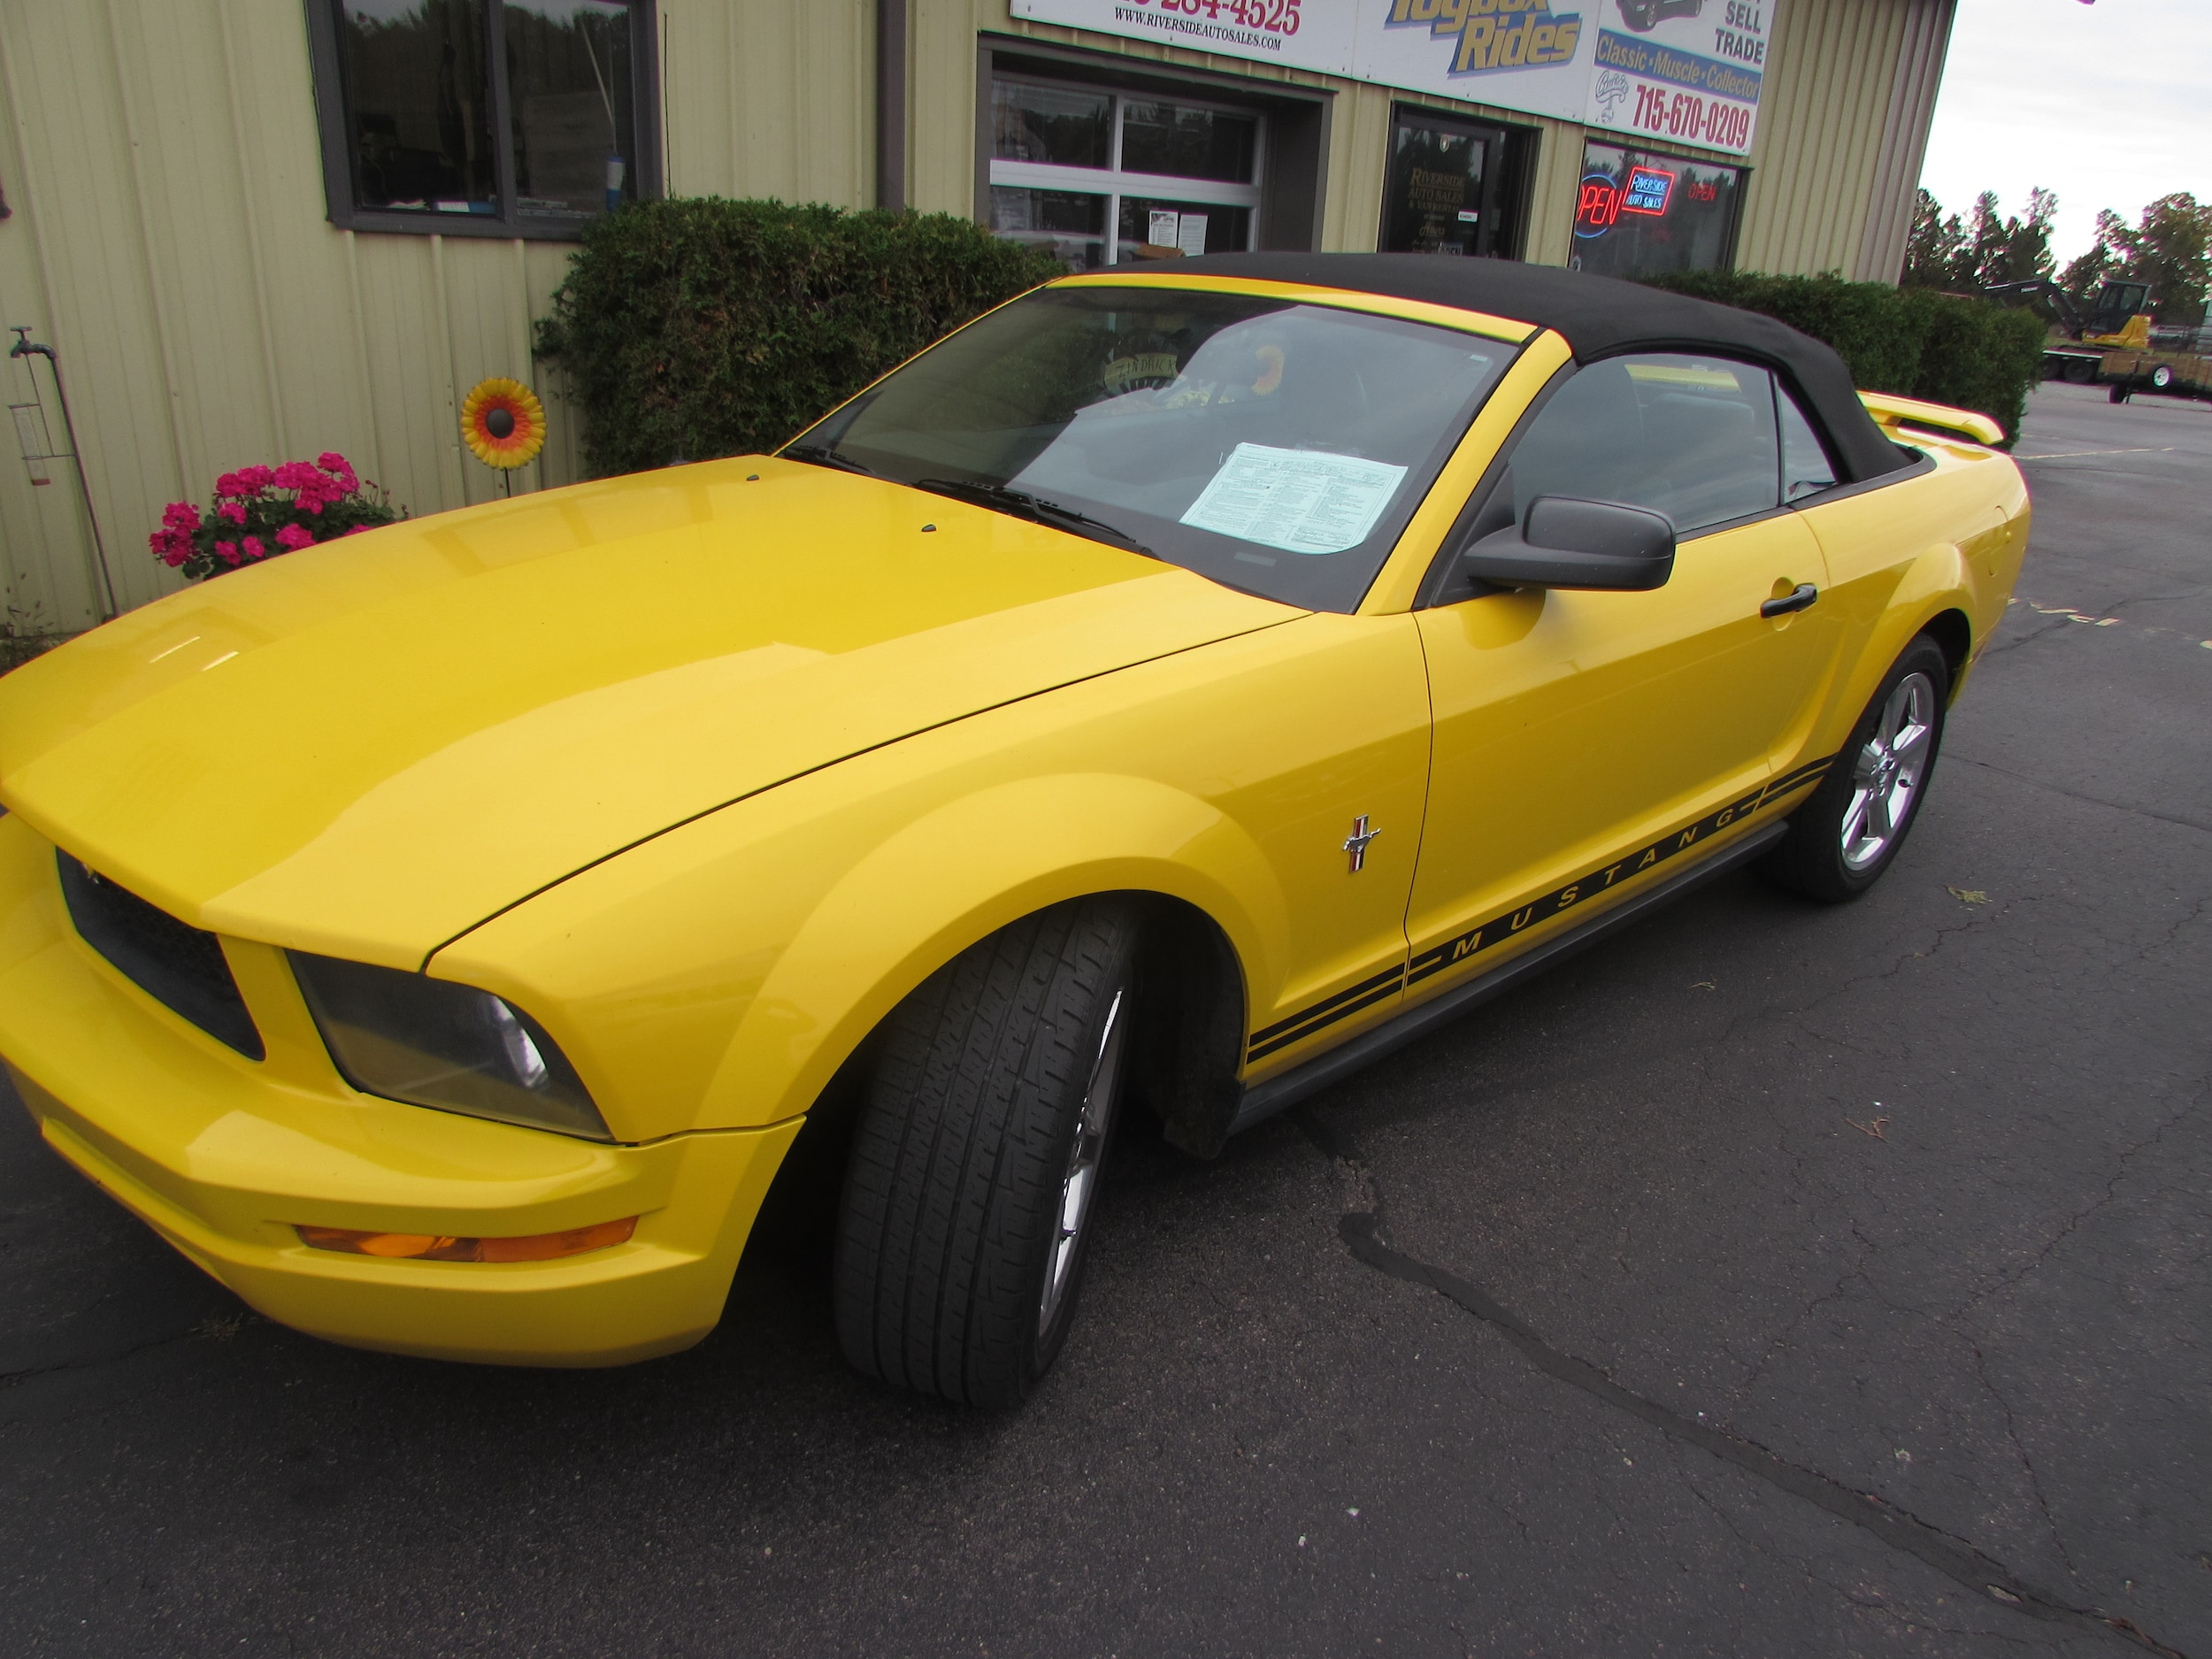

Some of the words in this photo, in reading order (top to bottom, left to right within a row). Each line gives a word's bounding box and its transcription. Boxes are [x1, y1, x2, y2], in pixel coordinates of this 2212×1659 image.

[1115, 7, 1281, 50] WWW.RIVERSIDEAUTOSALES.COM
[1455, 13, 1580, 72] Rides
[1724, 1, 1761, 35] SELL
[1597, 35, 1647, 71] Classic
[1654, 50, 1700, 84] Muscle
[1706, 65, 1761, 98] Collector
[1715, 28, 1765, 65] TRADE
[1633, 84, 1750, 149] 715-670-0209
[1408, 187, 1434, 200] AUTO
[1435, 190, 1464, 204] SALES
[1452, 807, 1734, 960] MUSTANG
